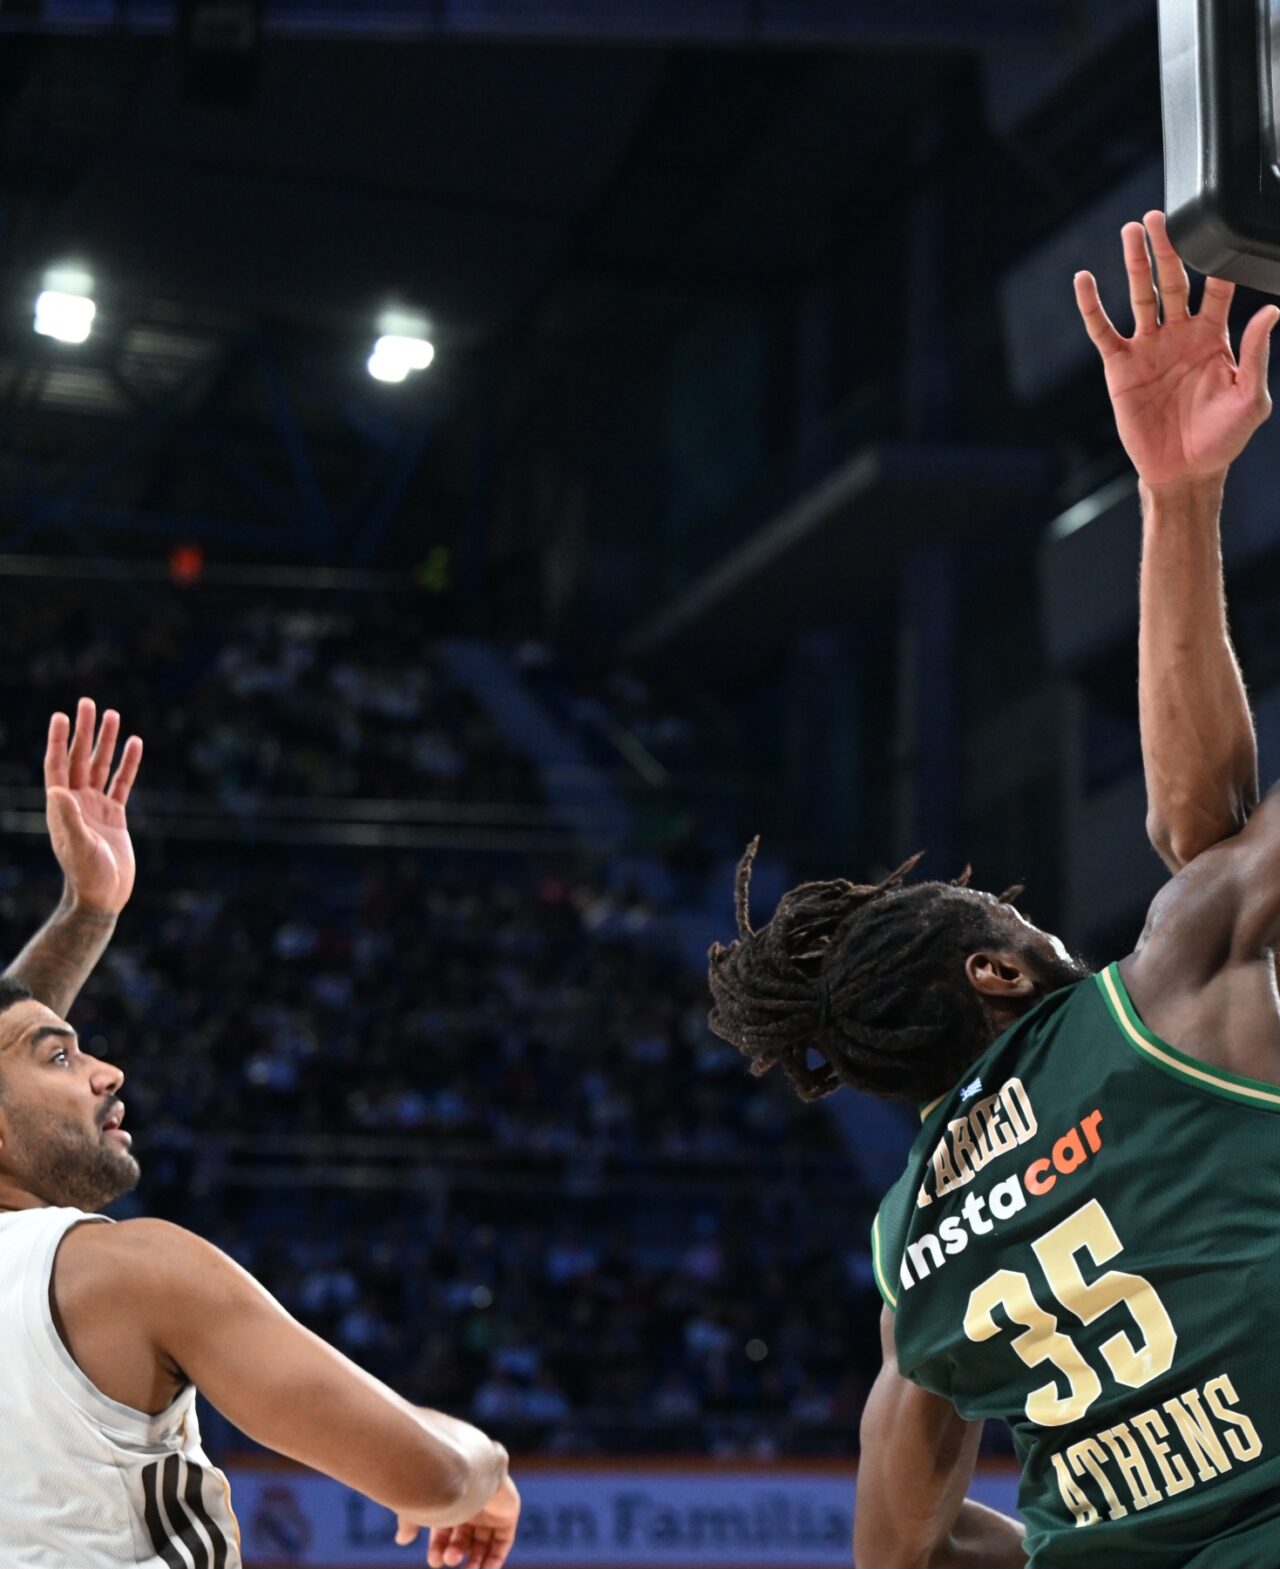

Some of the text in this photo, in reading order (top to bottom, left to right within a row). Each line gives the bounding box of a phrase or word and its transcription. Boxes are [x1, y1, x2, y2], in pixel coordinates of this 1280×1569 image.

[917, 1077, 1038, 1209] ARIED
[963, 1198, 1178, 1427] 35
[1050, 1373, 1263, 1528] ATHENS
